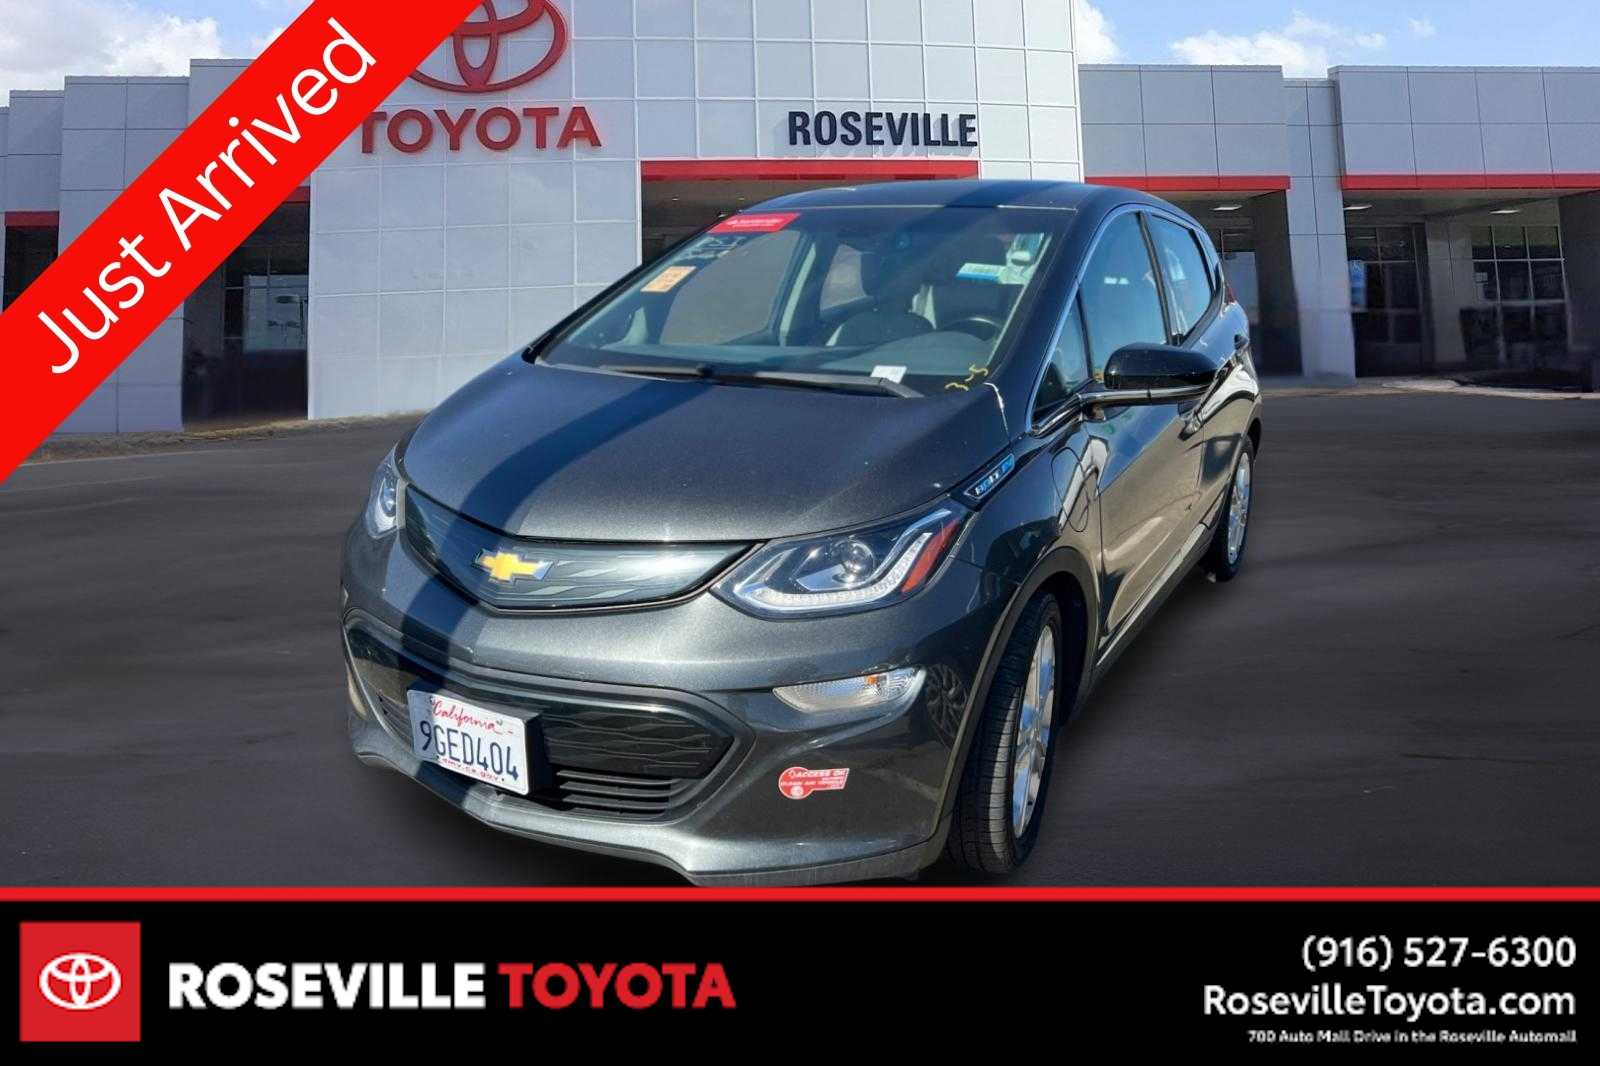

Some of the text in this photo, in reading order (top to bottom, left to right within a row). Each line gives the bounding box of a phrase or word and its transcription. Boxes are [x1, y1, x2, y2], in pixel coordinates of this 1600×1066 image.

[362, 106, 602, 153] TOYOTA
[788, 111, 978, 147] ROSEVILLE
[431, 700, 500, 731] California
[419, 720, 519, 781] 9GED404
